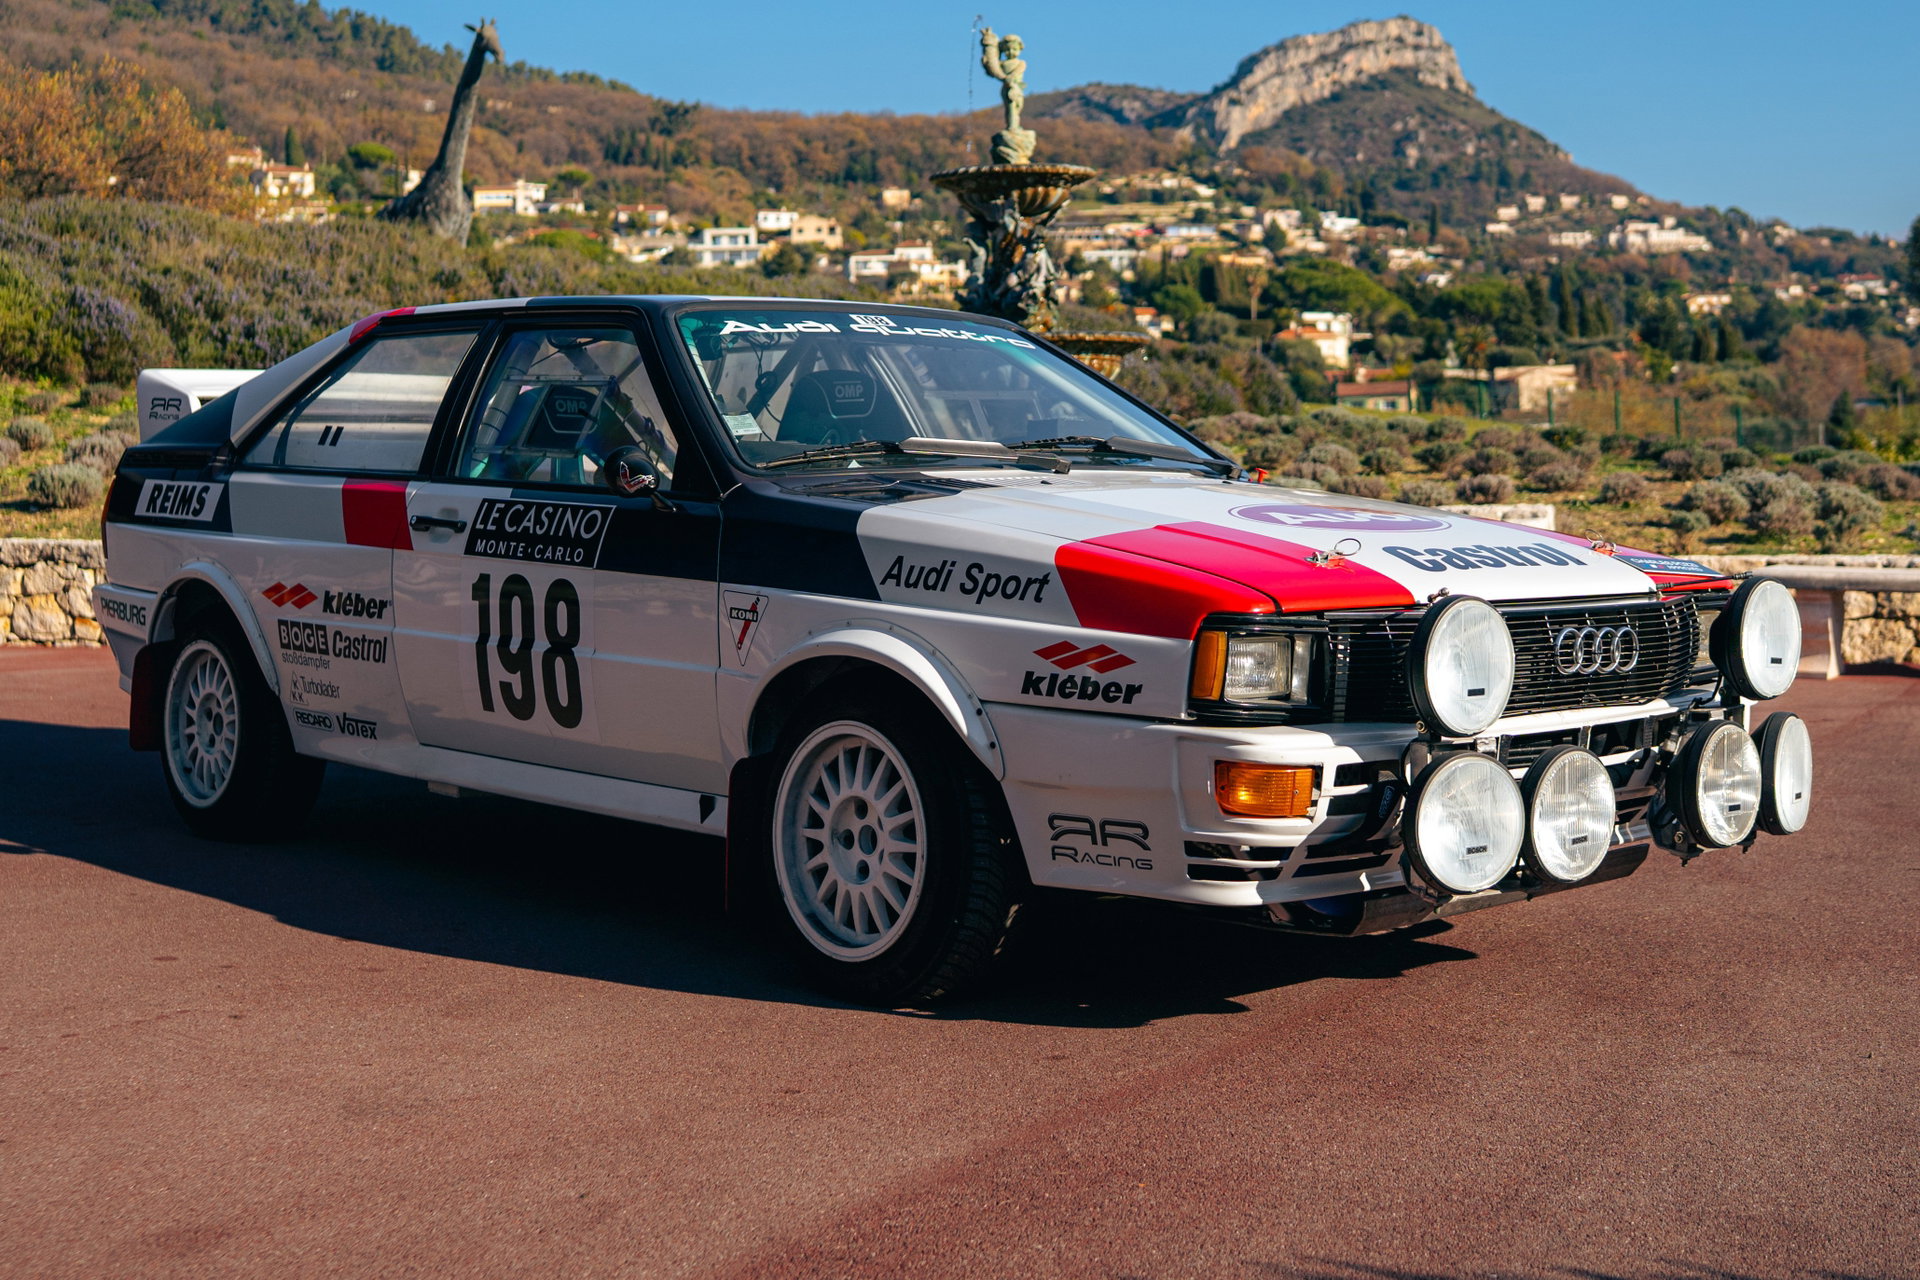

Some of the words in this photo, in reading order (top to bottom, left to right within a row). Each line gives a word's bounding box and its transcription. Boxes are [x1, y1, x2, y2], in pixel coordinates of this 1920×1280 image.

[719, 319, 841, 335] Audi
[849, 323, 1036, 349] quattro
[835, 384, 863, 398] OMP
[145, 483, 211, 517] REIMS
[475, 502, 505, 531] LE
[503, 504, 601, 539] CASINO
[1382, 543, 1588, 572] Castrol
[880, 555, 956, 592] Audi
[959, 563, 1050, 604] Sport
[100, 597, 146, 626] PIERBURG
[322, 590, 388, 619] kléber
[731, 608, 757, 621] KONI
[279, 621, 328, 653] BOGE
[332, 630, 387, 664] Castrol
[472, 573, 583, 729] 198
[300, 676, 340, 698] Turbolader
[1020, 670, 1143, 704] kléber
[295, 711, 332, 728] RECARO
[1466, 845, 1488, 855] BOSCH
